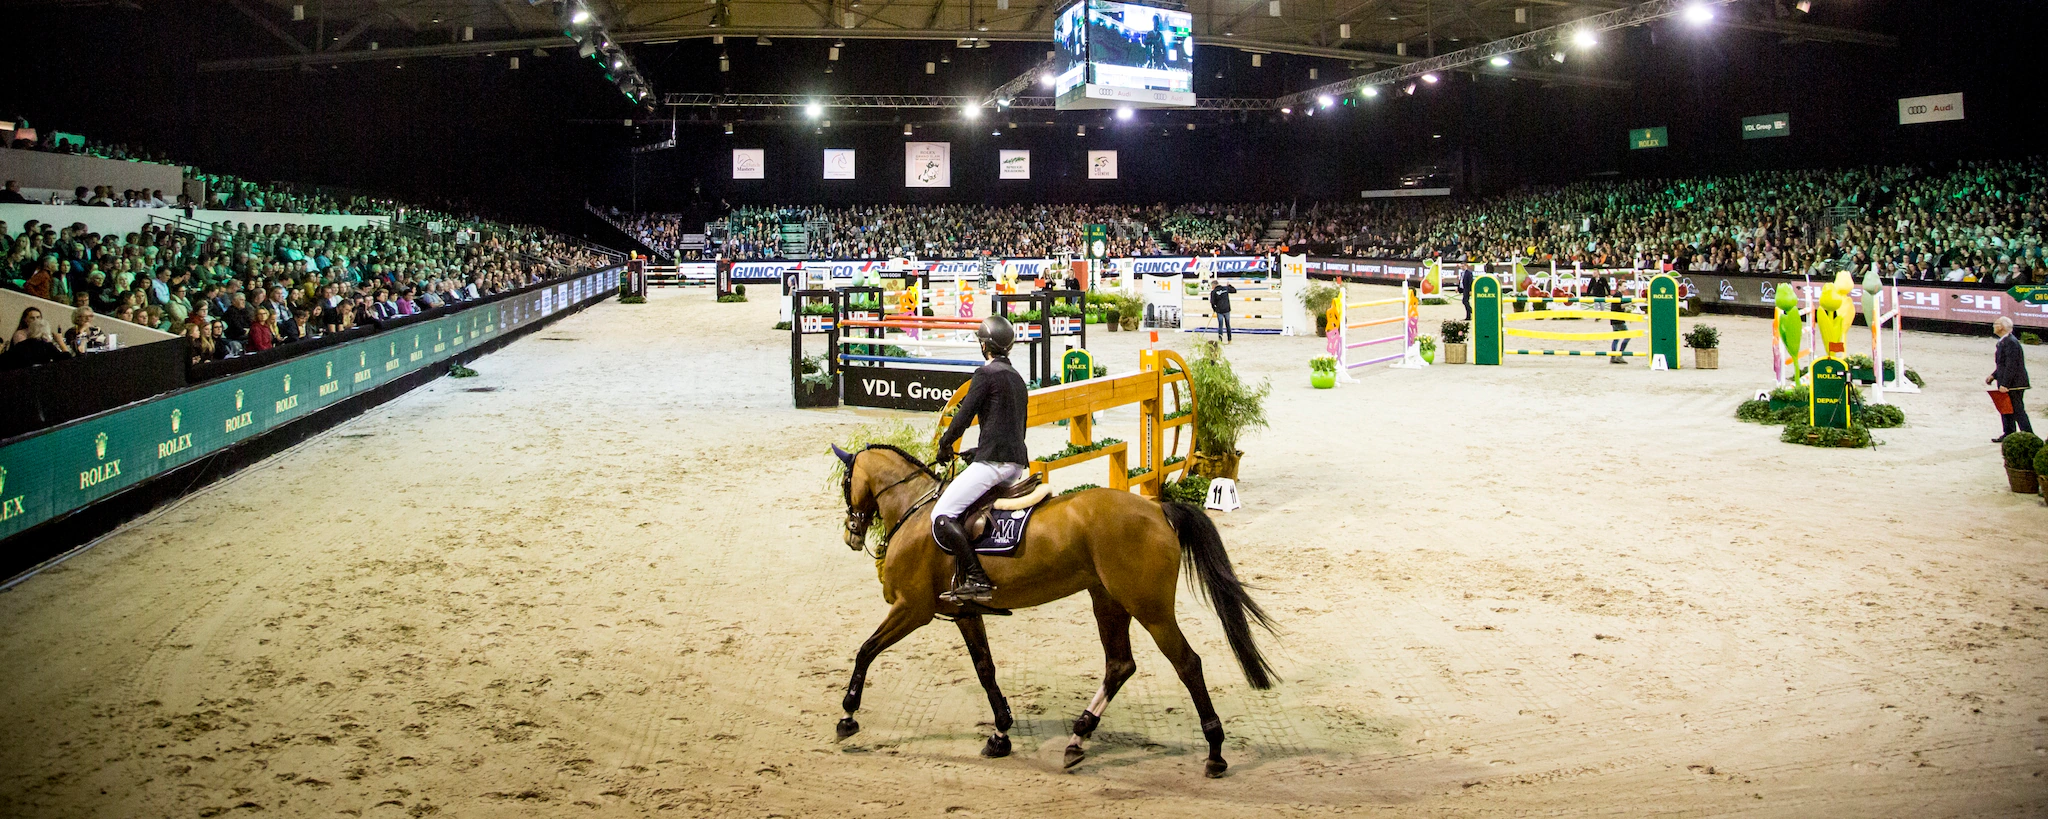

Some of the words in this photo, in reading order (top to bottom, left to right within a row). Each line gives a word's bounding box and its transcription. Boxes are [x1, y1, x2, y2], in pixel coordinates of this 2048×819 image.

[1933, 103, 1953, 112] Audi
[732, 266, 784, 279] GUNCO
[1133, 261, 1181, 273] GUNCO
[800, 315, 826, 333] VDL
[1049, 317, 1074, 334] VDL
[354, 368, 371, 383] ROLEX
[319, 380, 338, 397] ROLEX
[862, 378, 902, 398] VDL
[907, 381, 957, 401] Groe
[276, 394, 298, 414] ROLEX
[225, 411, 252, 433] ROLEX
[158, 433, 192, 459] ROLEX
[80, 459, 121, 490] ROLEX
[1213, 484, 1223, 505] 11
